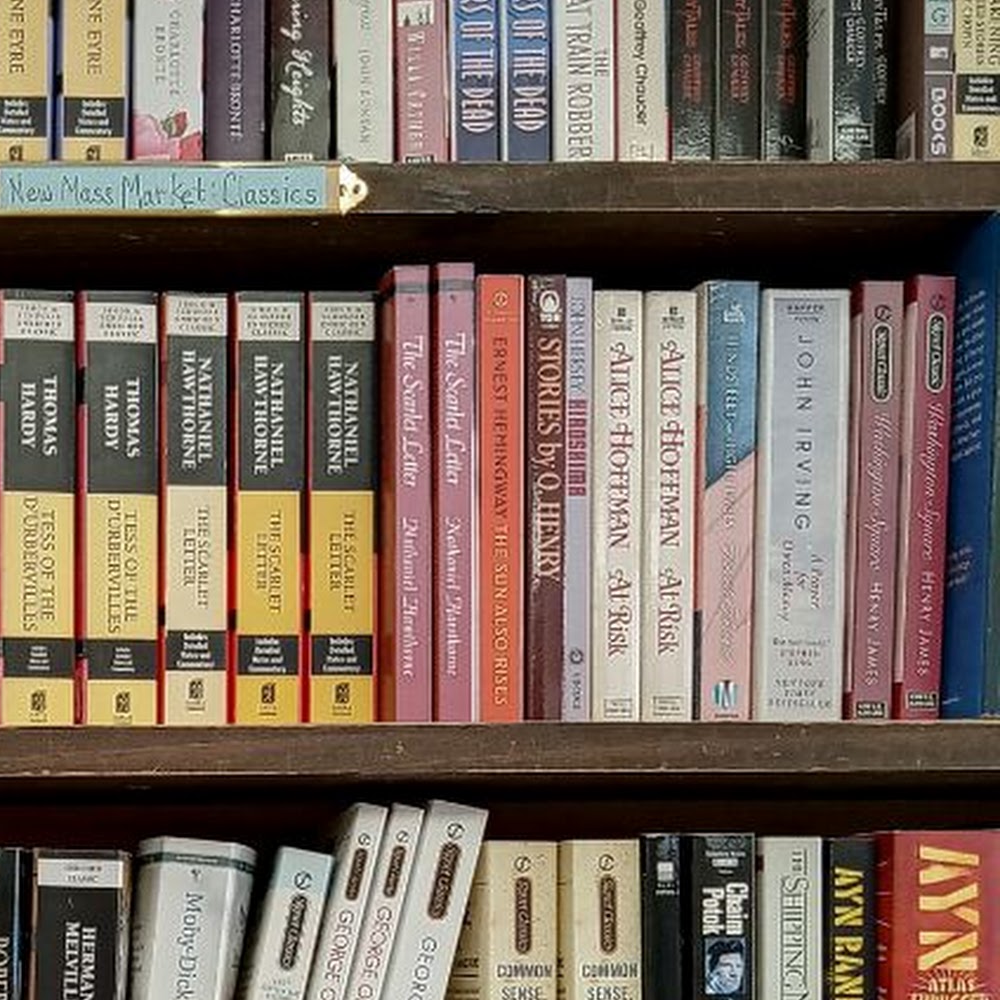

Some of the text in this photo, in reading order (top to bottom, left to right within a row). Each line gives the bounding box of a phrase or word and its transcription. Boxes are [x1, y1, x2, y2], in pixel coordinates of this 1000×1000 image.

[285, 49, 315, 126] Heights
[462, 20, 494, 133] OF THE DEAD
[567, 24, 592, 78] TRAIN
[594, 47, 608, 78] THE
[634, 64, 648, 126] Chaucer
[930, 87, 947, 155] BOOKS
[7, 173, 318, 209] New Mass Market Classics
[20, 381, 36, 450] HARDY
[41, 374, 58, 457] THOMAS
[253, 354, 270, 476] HAWTHORNE
[269, 361, 286, 468] NATHANIEL
[400, 334, 425, 488] The Scarlet Letter
[794, 335, 815, 530] JOHN IRVING
[534, 338, 561, 584] STORIES by O. HENRY
[657, 340, 685, 653] ALICE HOFFMAN At Risk
[493, 337, 510, 706] ERNEST HEMINGWAY THE SUN ALSO RISES
[702, 886, 725, 937] Potok
[724, 881, 749, 937] Chaim
[782, 875, 809, 990] SHIPPING
[832, 866, 865, 927] AYN
[918, 844, 980, 972] AYN
[496, 964, 553, 978] COMMON
[928, 976, 977, 993] ATLAS
